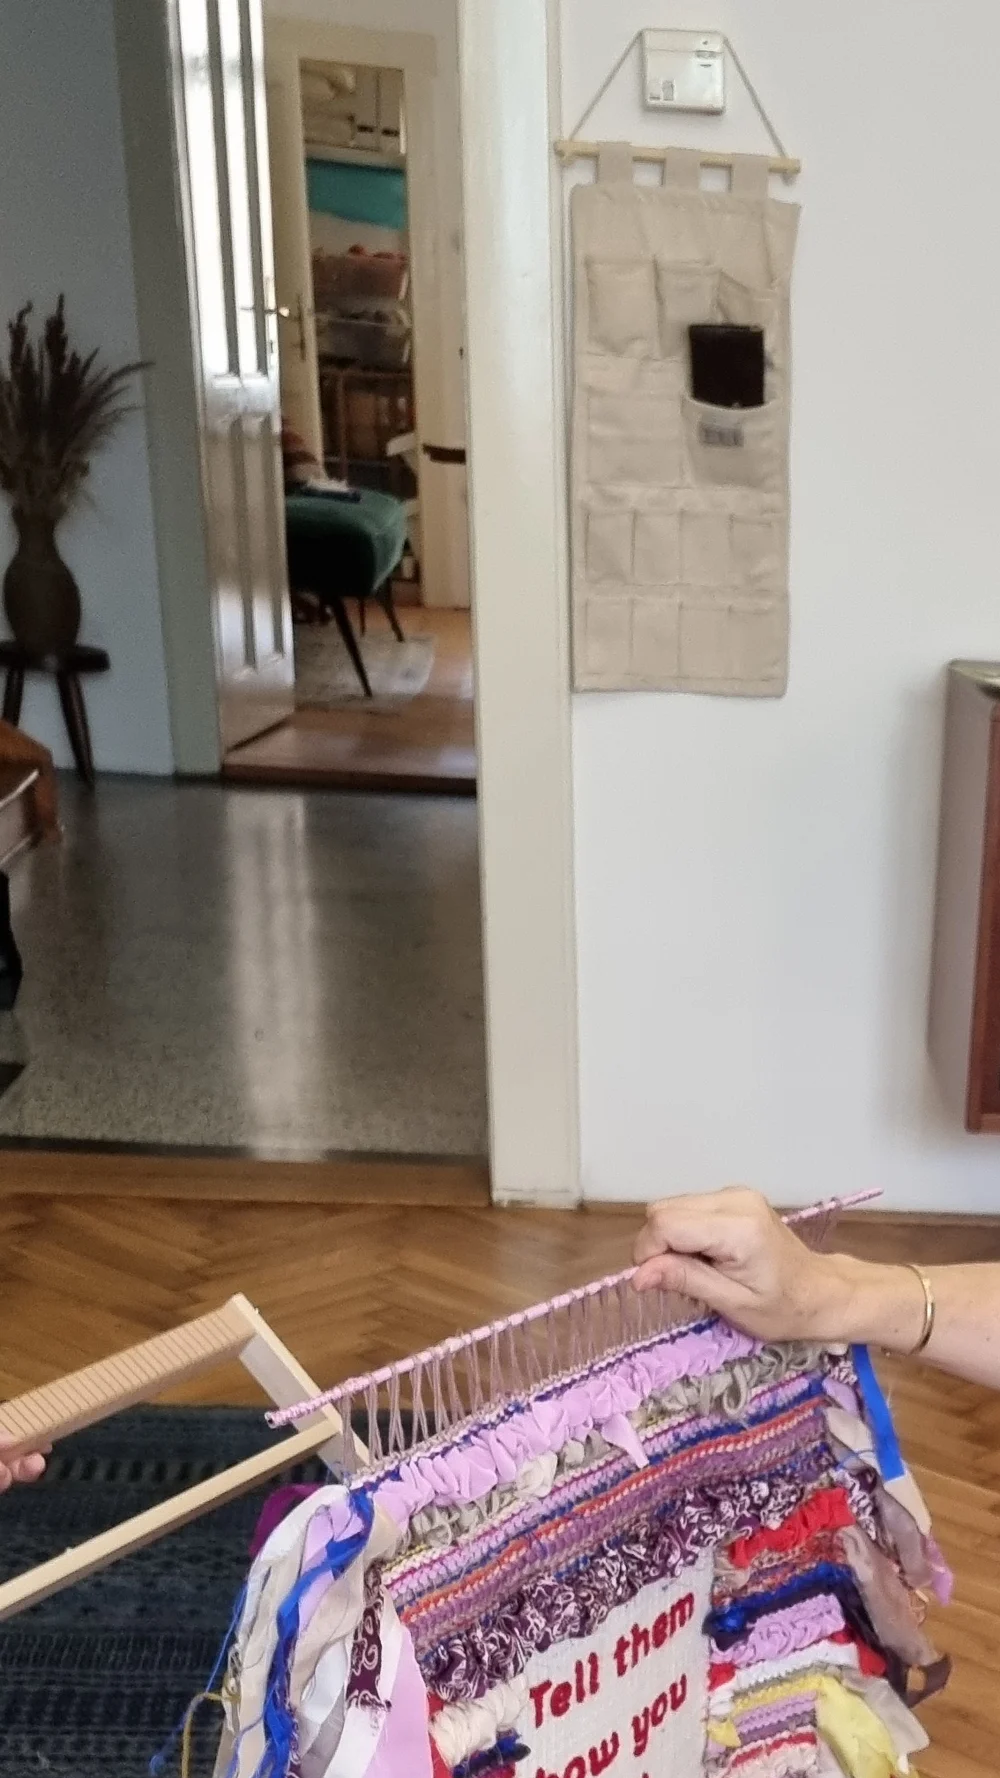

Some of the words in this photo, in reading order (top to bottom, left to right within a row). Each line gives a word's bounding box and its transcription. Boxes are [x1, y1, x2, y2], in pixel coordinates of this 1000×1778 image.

[530, 1652, 599, 1728] Tell
[614, 1592, 695, 1677] them
[632, 1674, 687, 1757] you
